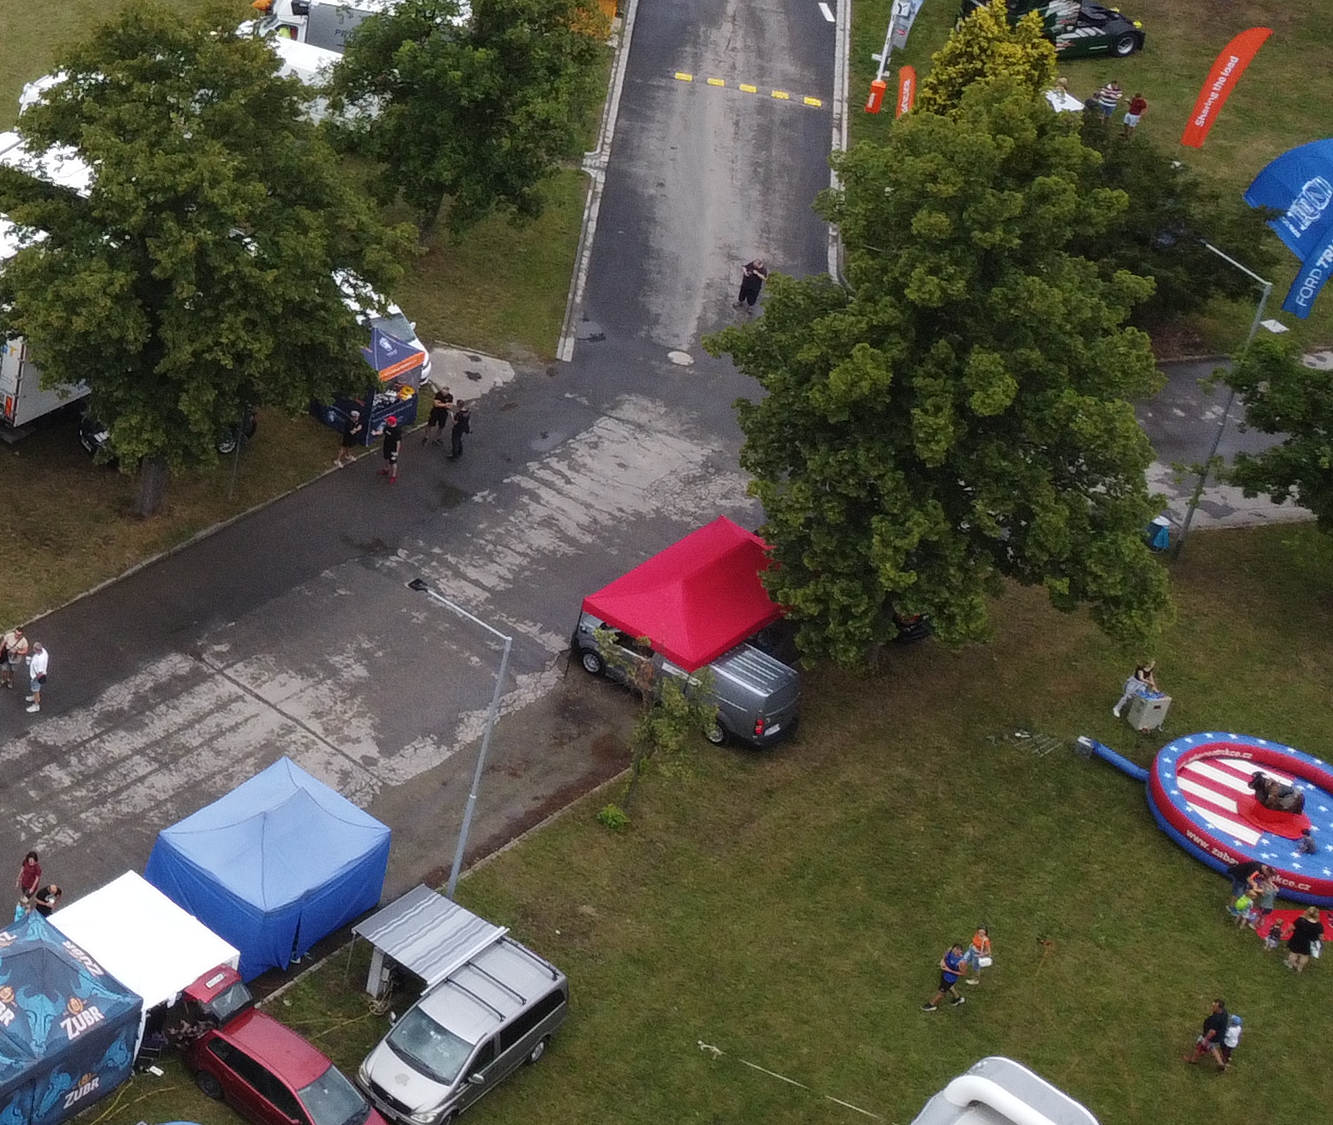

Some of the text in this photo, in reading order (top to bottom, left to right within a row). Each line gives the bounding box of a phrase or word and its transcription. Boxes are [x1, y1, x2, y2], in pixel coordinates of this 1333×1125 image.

[1195, 55, 1239, 127] Sharing the load
[1295, 268, 1323, 307] FORD
[1186, 829, 1210, 850] www.
[60, 1006, 105, 1041] ZUBR
[63, 1076, 100, 1110] ZUBR
